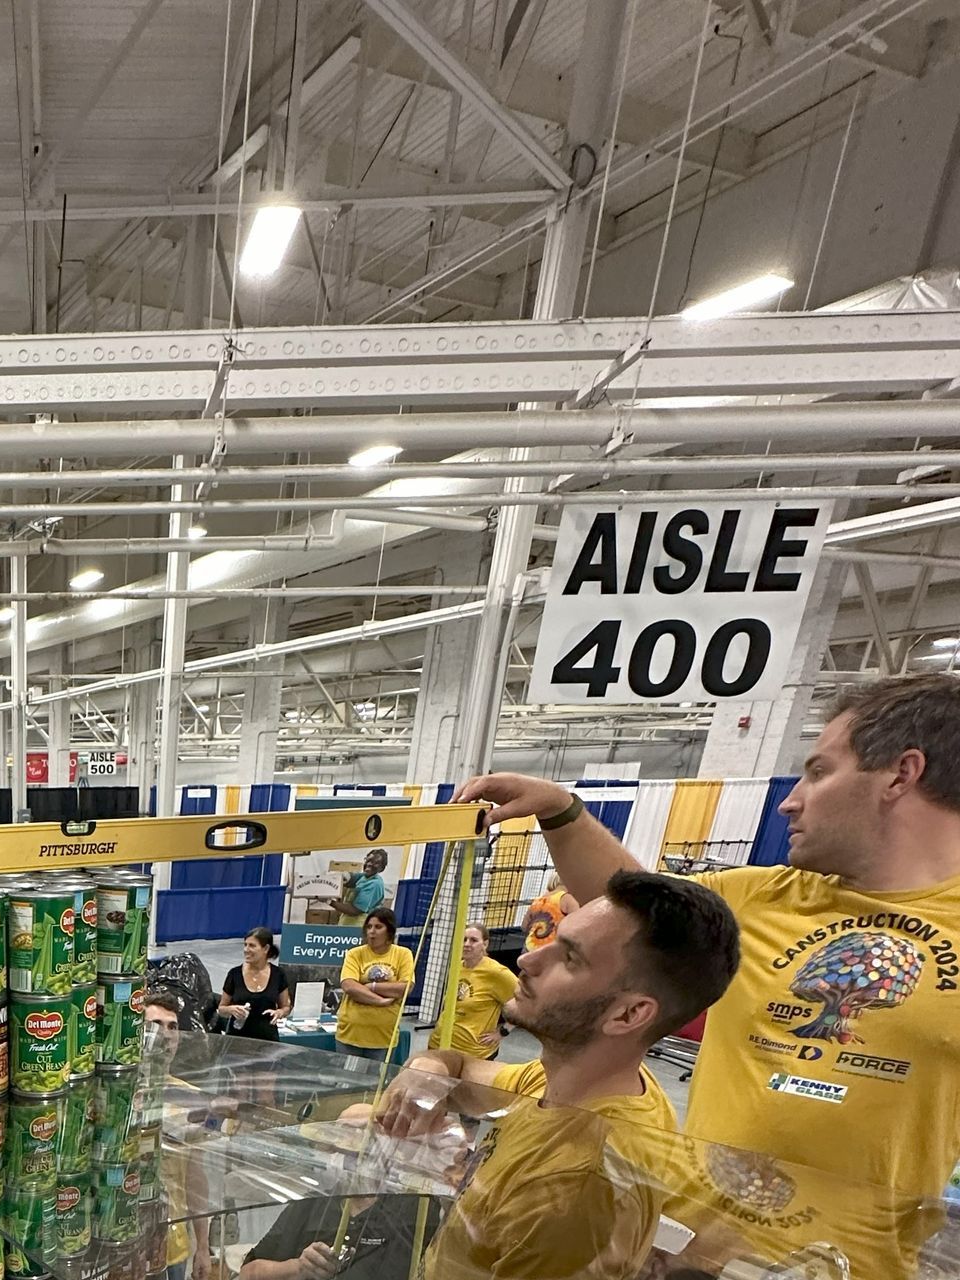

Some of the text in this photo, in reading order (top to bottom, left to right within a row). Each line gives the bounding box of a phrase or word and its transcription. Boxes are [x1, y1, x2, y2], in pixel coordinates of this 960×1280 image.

[562, 508, 820, 595] AISLE
[551, 618, 772, 698] 400
[90, 752, 115, 762] AISLE
[90, 764, 114, 774] 500
[39, 842, 117, 858] PITTSBURGH
[305, 933, 362, 946] Empower
[293, 947, 348, 958] Every Fut
[773, 913, 959, 991] CANSTRUCTION 2024
[767, 1002, 813, 1025] smps
[28, 1019, 63, 1029] Del Monte
[28, 1043, 58, 1052] Fresh Cut
[36, 1055, 52, 1064] CUT
[21, 1062, 44, 1072] GREEN
[790, 1078, 844, 1093] KENNY
[795, 1086, 844, 1100] GLASS
